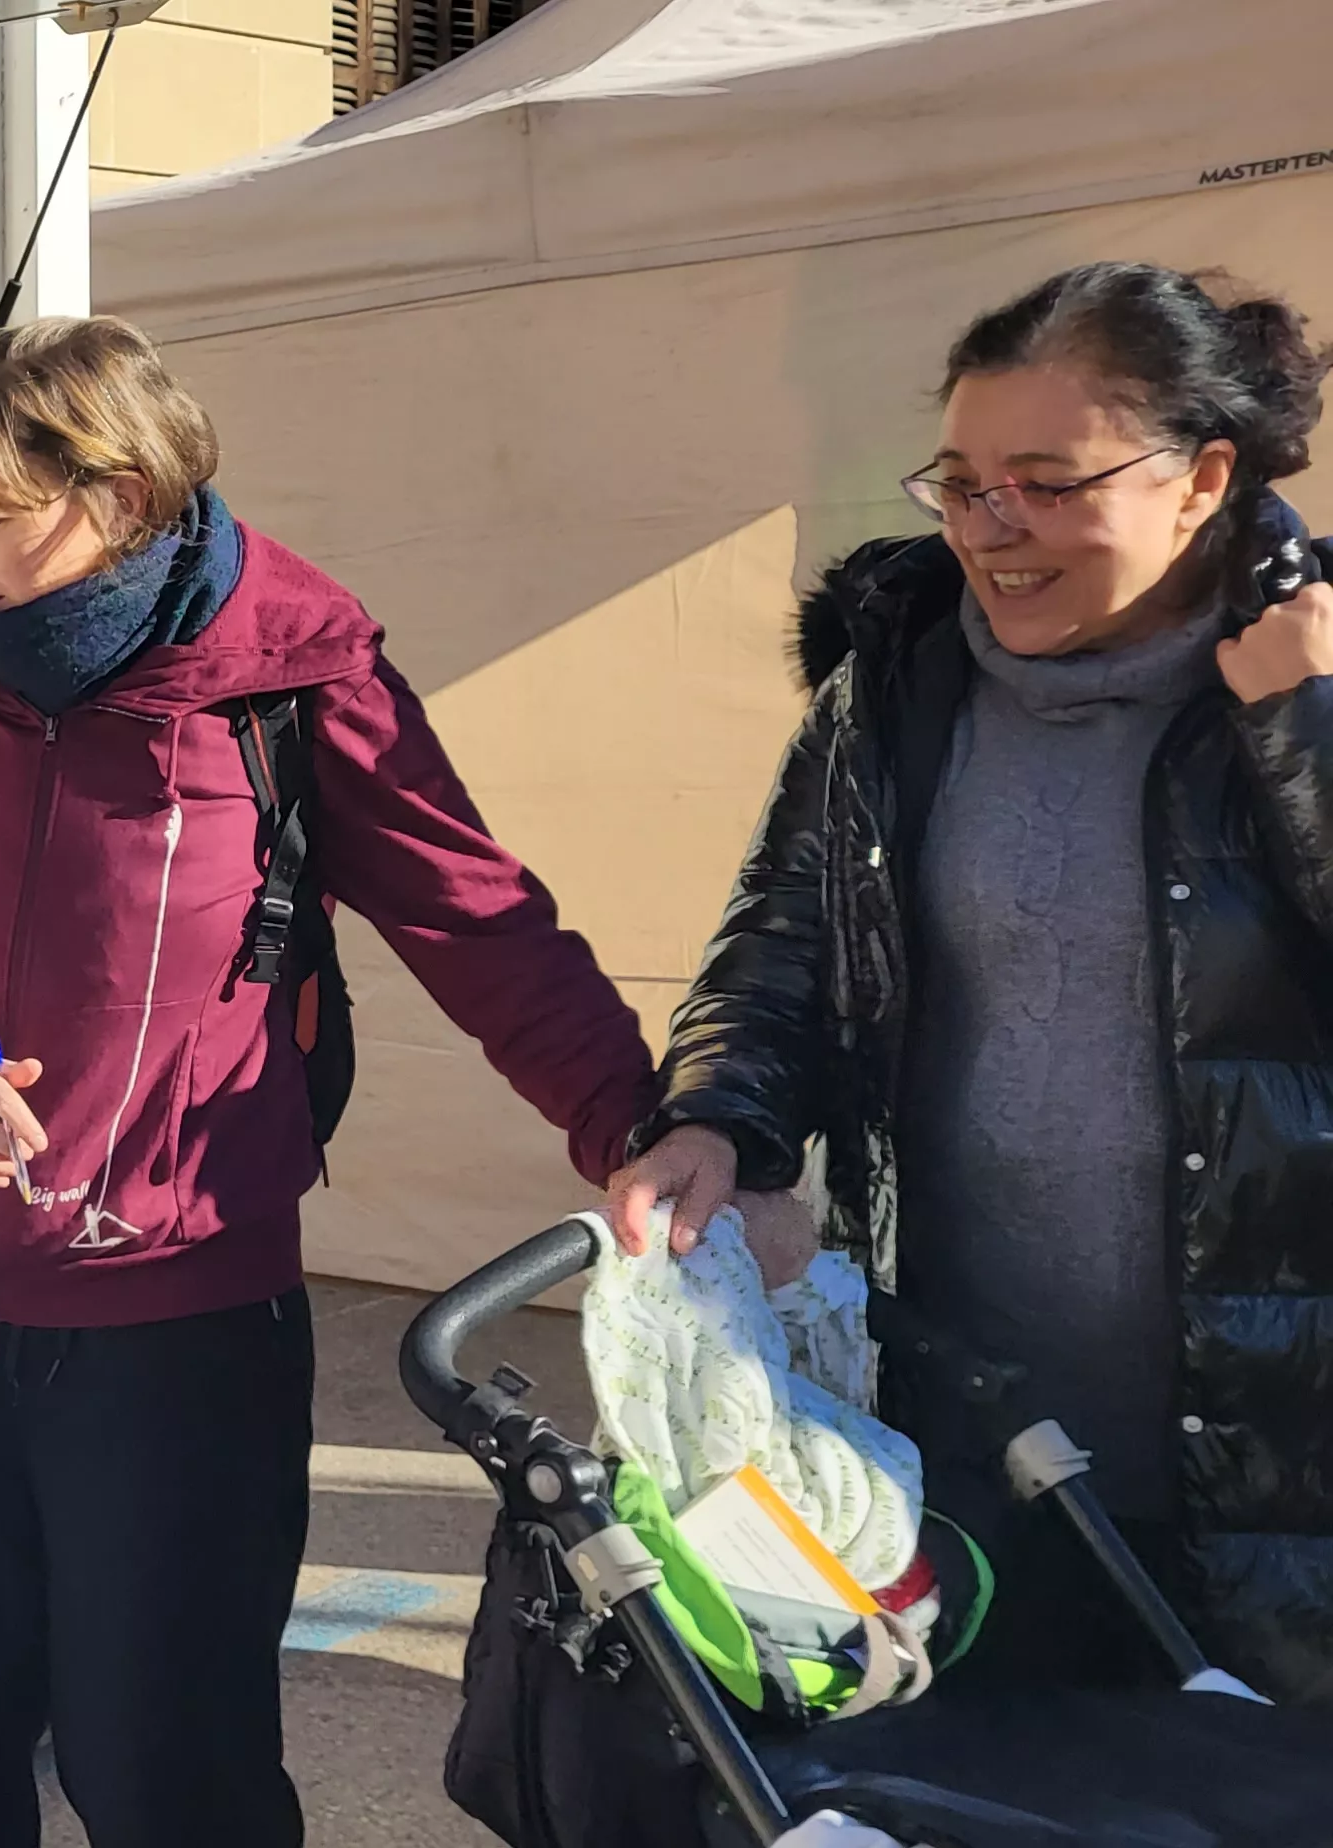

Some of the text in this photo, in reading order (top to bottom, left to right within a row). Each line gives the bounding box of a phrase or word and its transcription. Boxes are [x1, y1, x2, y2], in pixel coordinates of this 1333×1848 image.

[1199, 149, 1333, 185] MASTERTEN
[31, 1179, 91, 1213] Big wall
